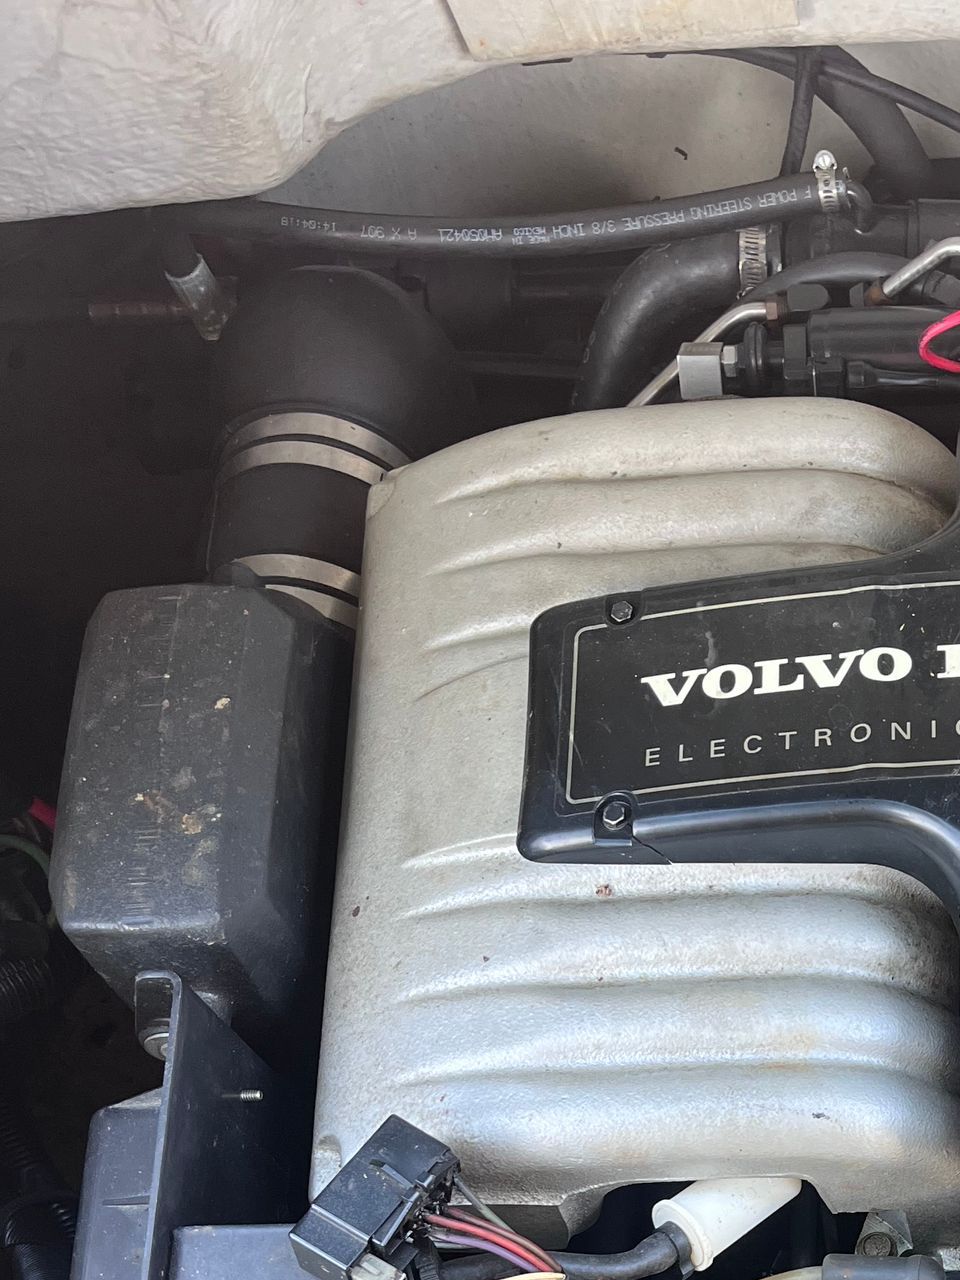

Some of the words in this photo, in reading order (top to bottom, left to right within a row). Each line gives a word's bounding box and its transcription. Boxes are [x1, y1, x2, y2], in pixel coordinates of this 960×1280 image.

[758, 188, 797, 208] POWER
[690, 197, 753, 220] STEERING
[552, 223, 586, 239] INCH
[591, 220, 617, 235] 3/8
[621, 211, 685, 231] PRESSURE
[360, 225, 385, 239] 907
[640, 646, 913, 707] VOLVO
